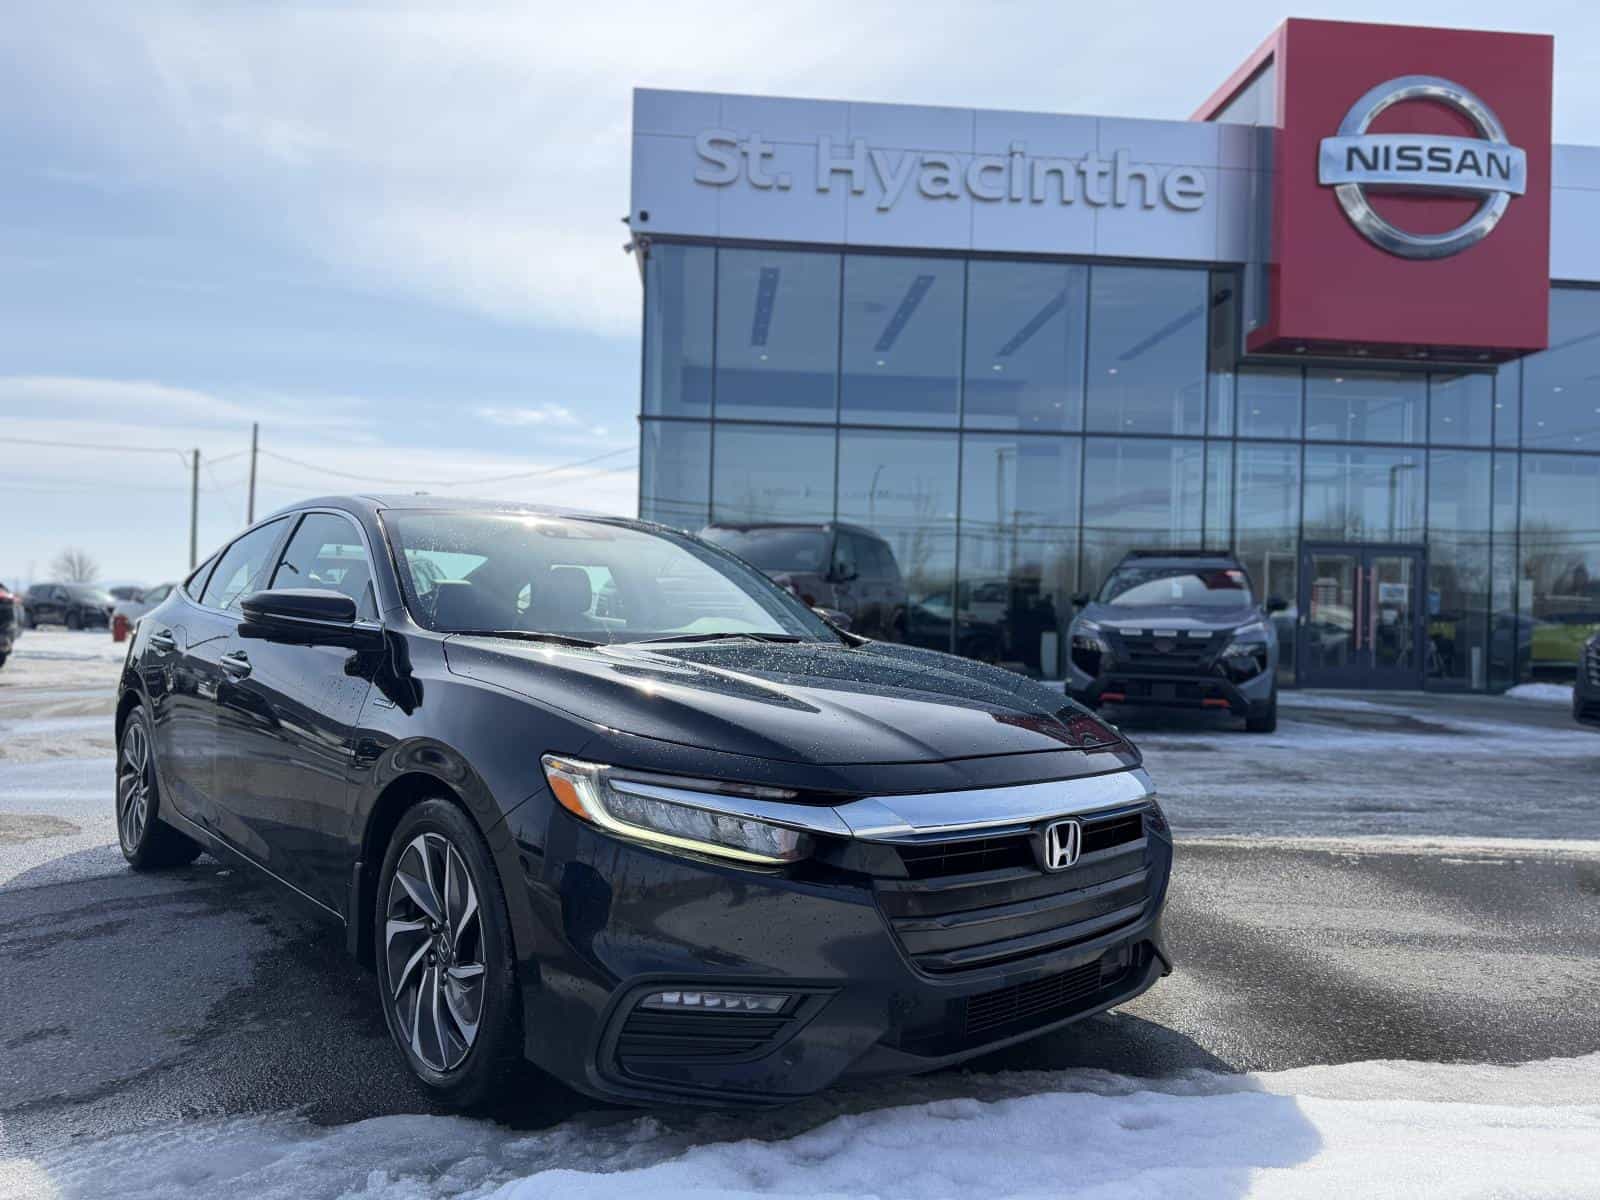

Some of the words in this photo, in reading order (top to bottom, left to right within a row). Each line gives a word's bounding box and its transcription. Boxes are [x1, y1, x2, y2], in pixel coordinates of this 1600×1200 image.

[695, 128, 791, 190] St.
[816, 135, 1207, 213] Hyacinthe
[1346, 146, 1510, 180] NISSAN
